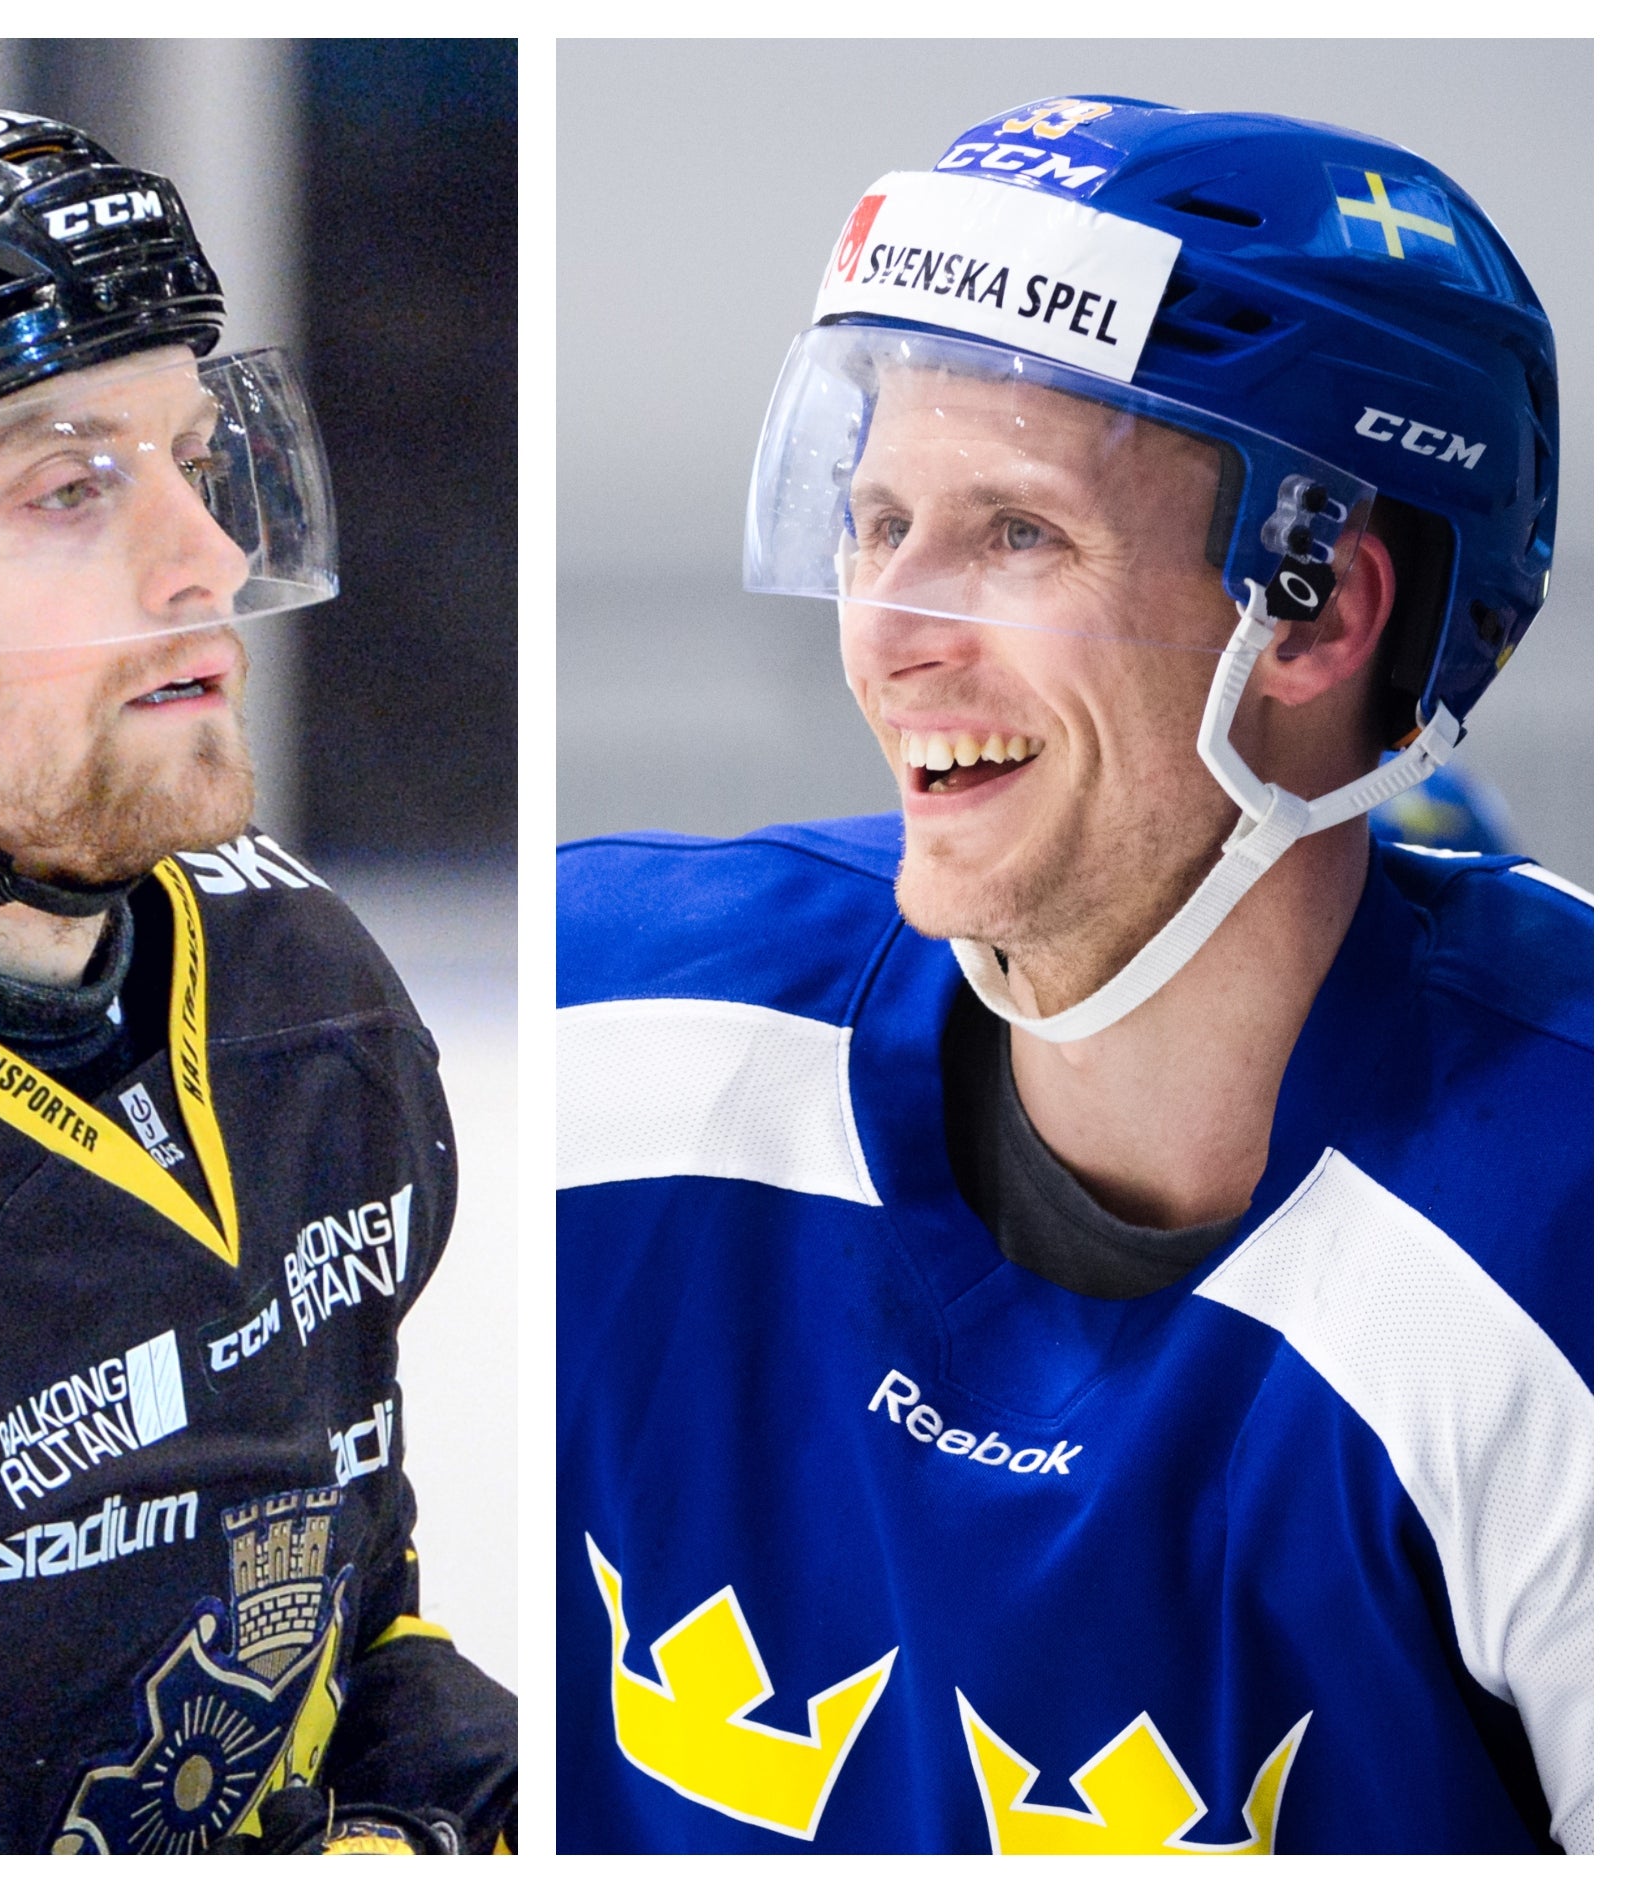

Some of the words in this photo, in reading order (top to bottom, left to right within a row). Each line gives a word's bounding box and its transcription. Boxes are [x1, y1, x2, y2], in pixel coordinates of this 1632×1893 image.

[936, 142, 1108, 189] CCM
[42, 190, 164, 240] CCM
[861, 243, 1010, 309] SVENSKA
[1017, 274, 1120, 346] SPEL
[1354, 406, 1487, 470] CCM
[207, 1298, 281, 1373] CCM
[0, 1402, 140, 1510] RUTAN
[867, 1368, 1084, 1475] Reebok
